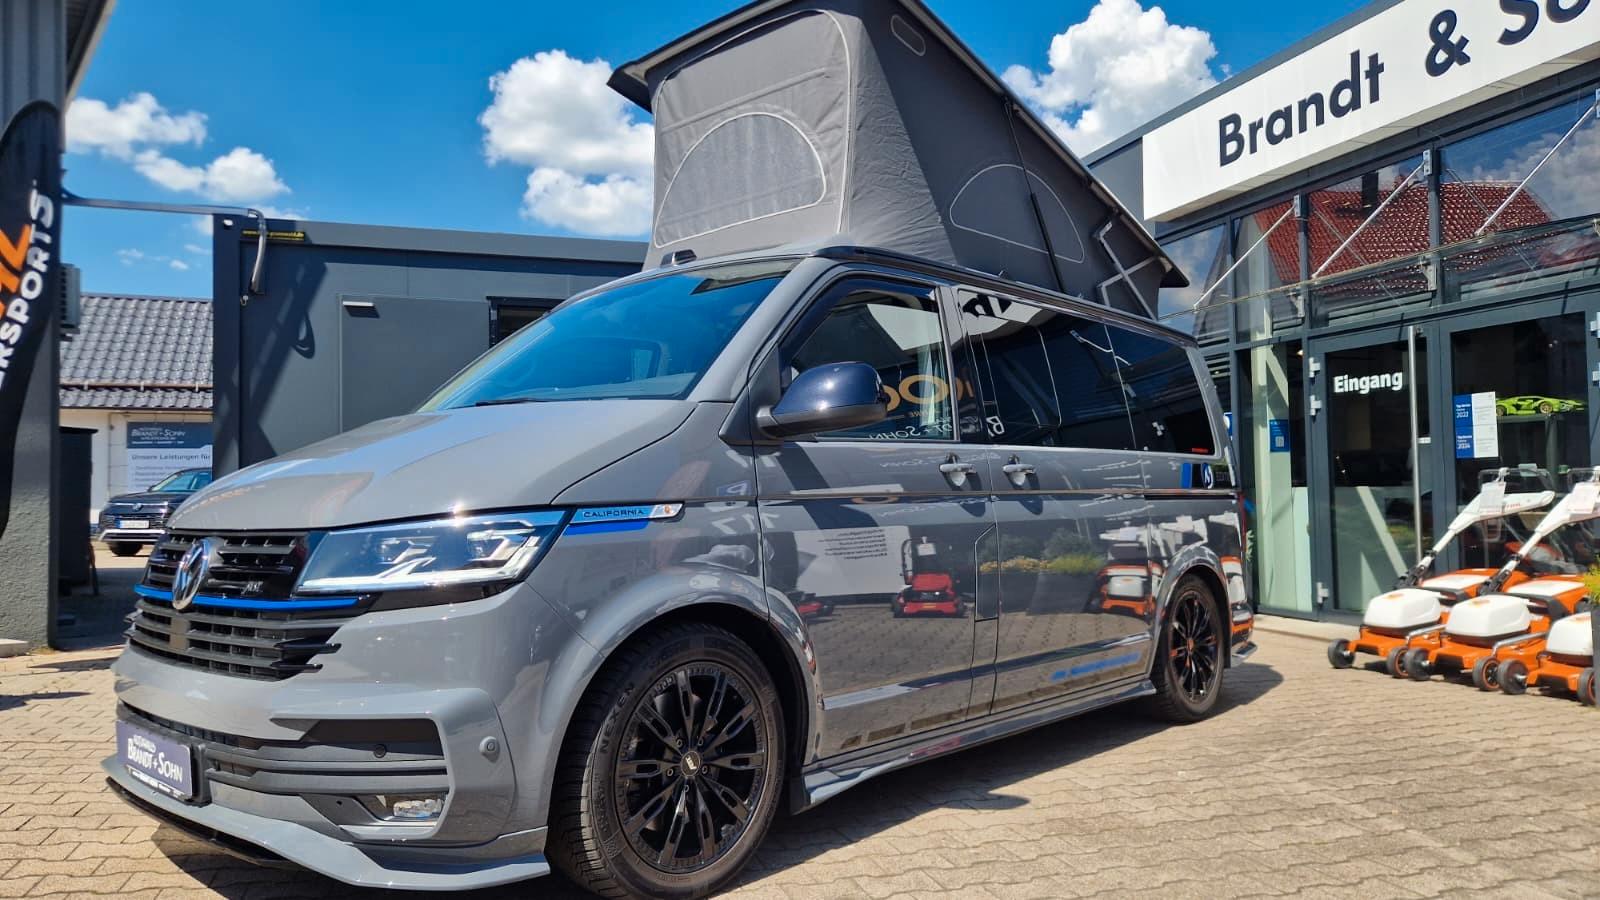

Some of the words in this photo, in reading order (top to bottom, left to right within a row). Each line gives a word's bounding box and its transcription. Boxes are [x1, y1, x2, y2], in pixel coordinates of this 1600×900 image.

[1218, 49, 1385, 167] Brandt
[1425, 9, 1471, 77] &
[0, 187, 54, 388] RSPORTS
[1333, 371, 1404, 393] Eingang
[583, 509, 645, 518] CALIFORNIA
